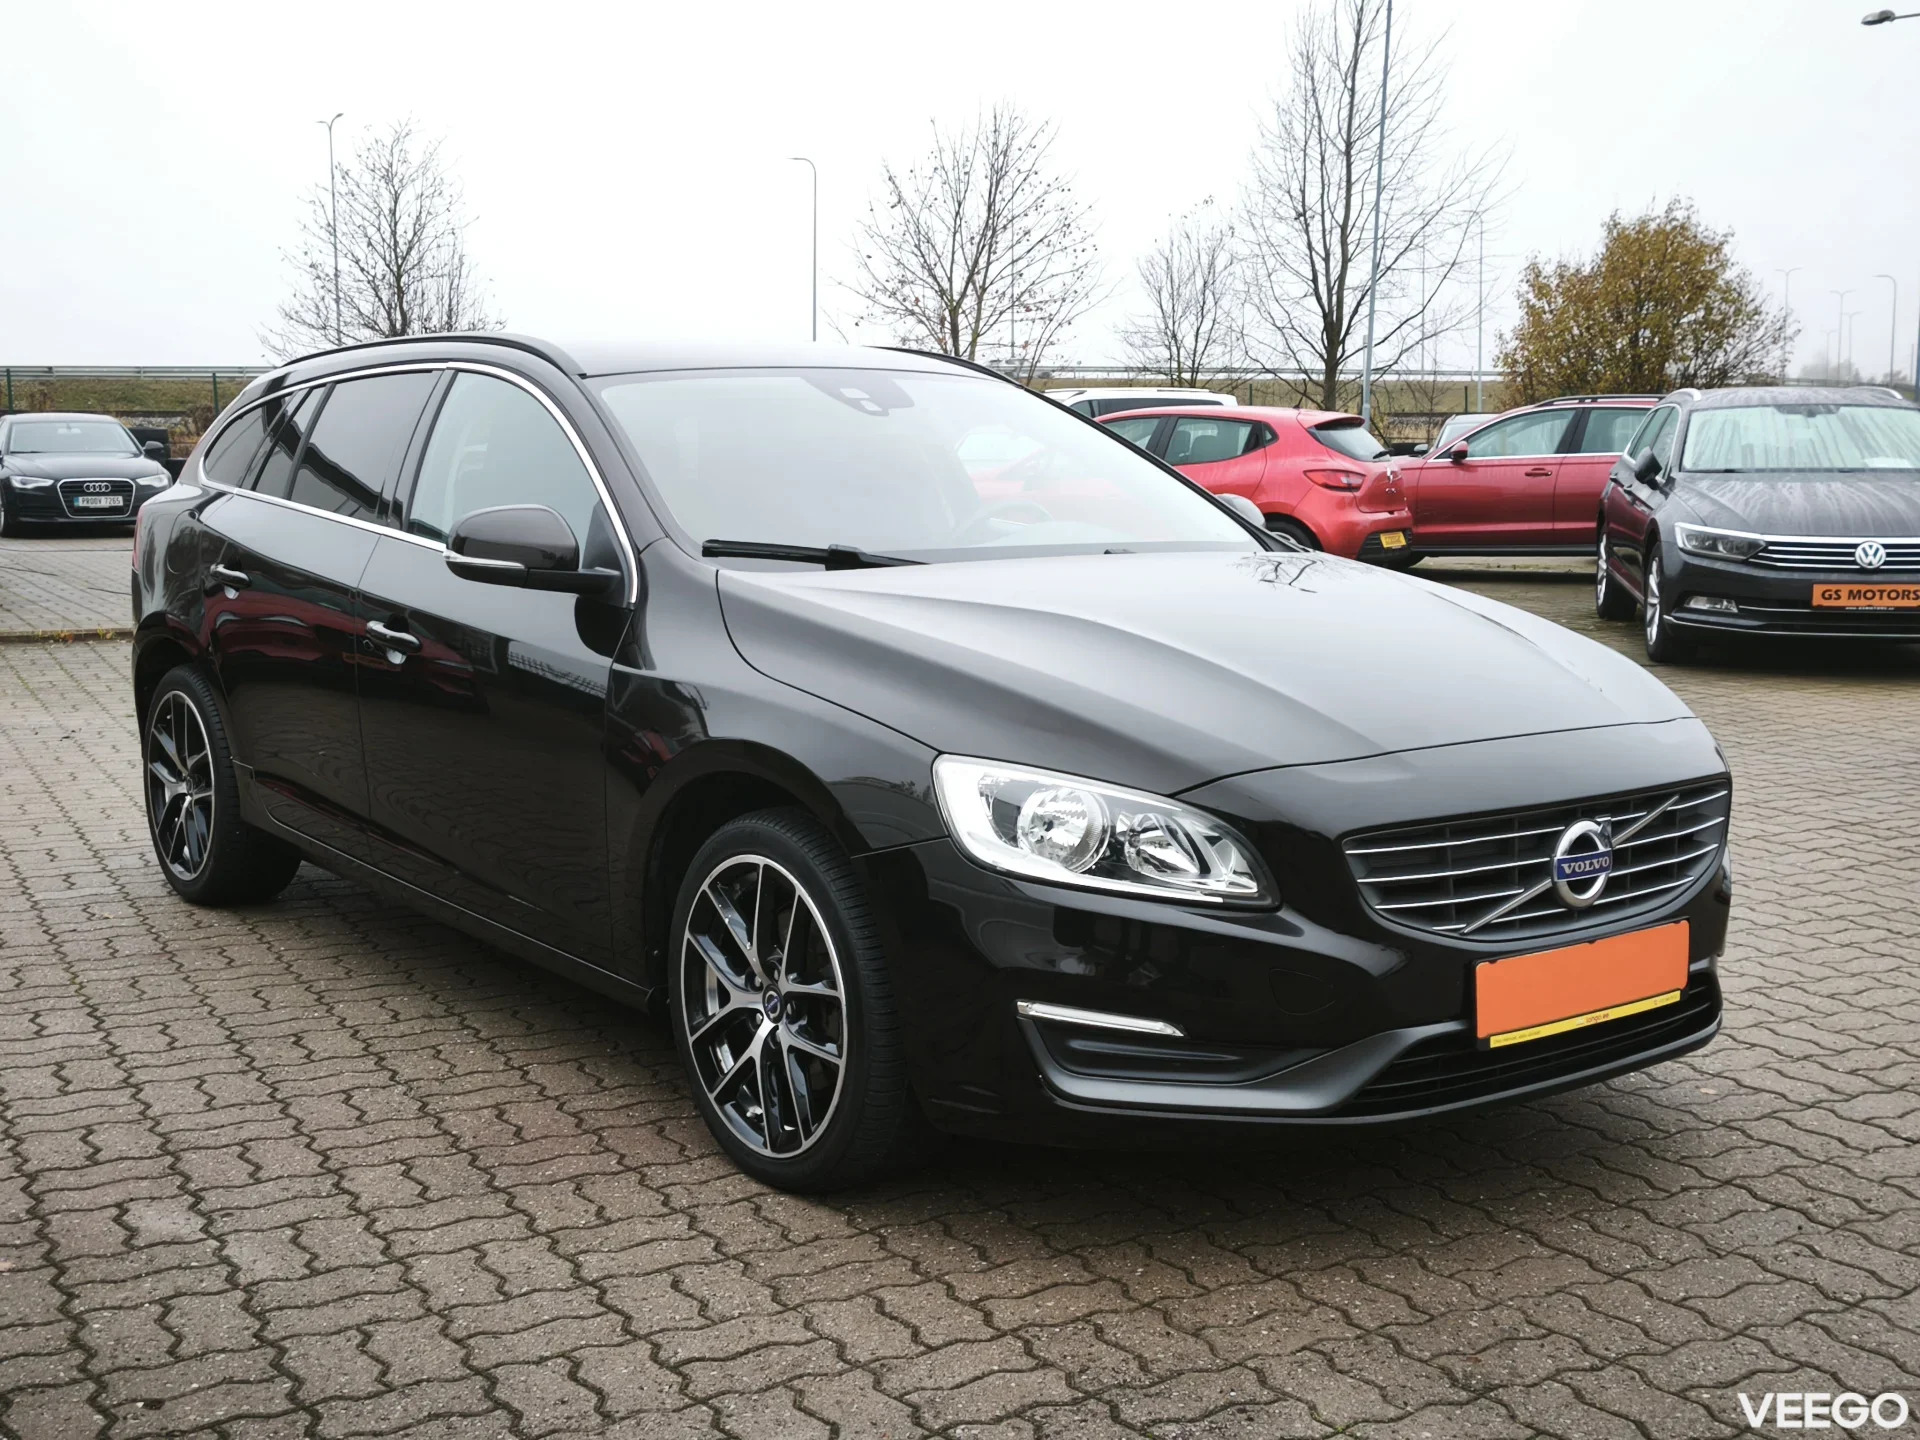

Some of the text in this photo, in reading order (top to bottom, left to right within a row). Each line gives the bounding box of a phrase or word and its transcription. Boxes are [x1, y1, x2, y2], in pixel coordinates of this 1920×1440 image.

[1821, 589, 1920, 601] GS MOTORS
[1561, 856, 1610, 874] VOLVO
